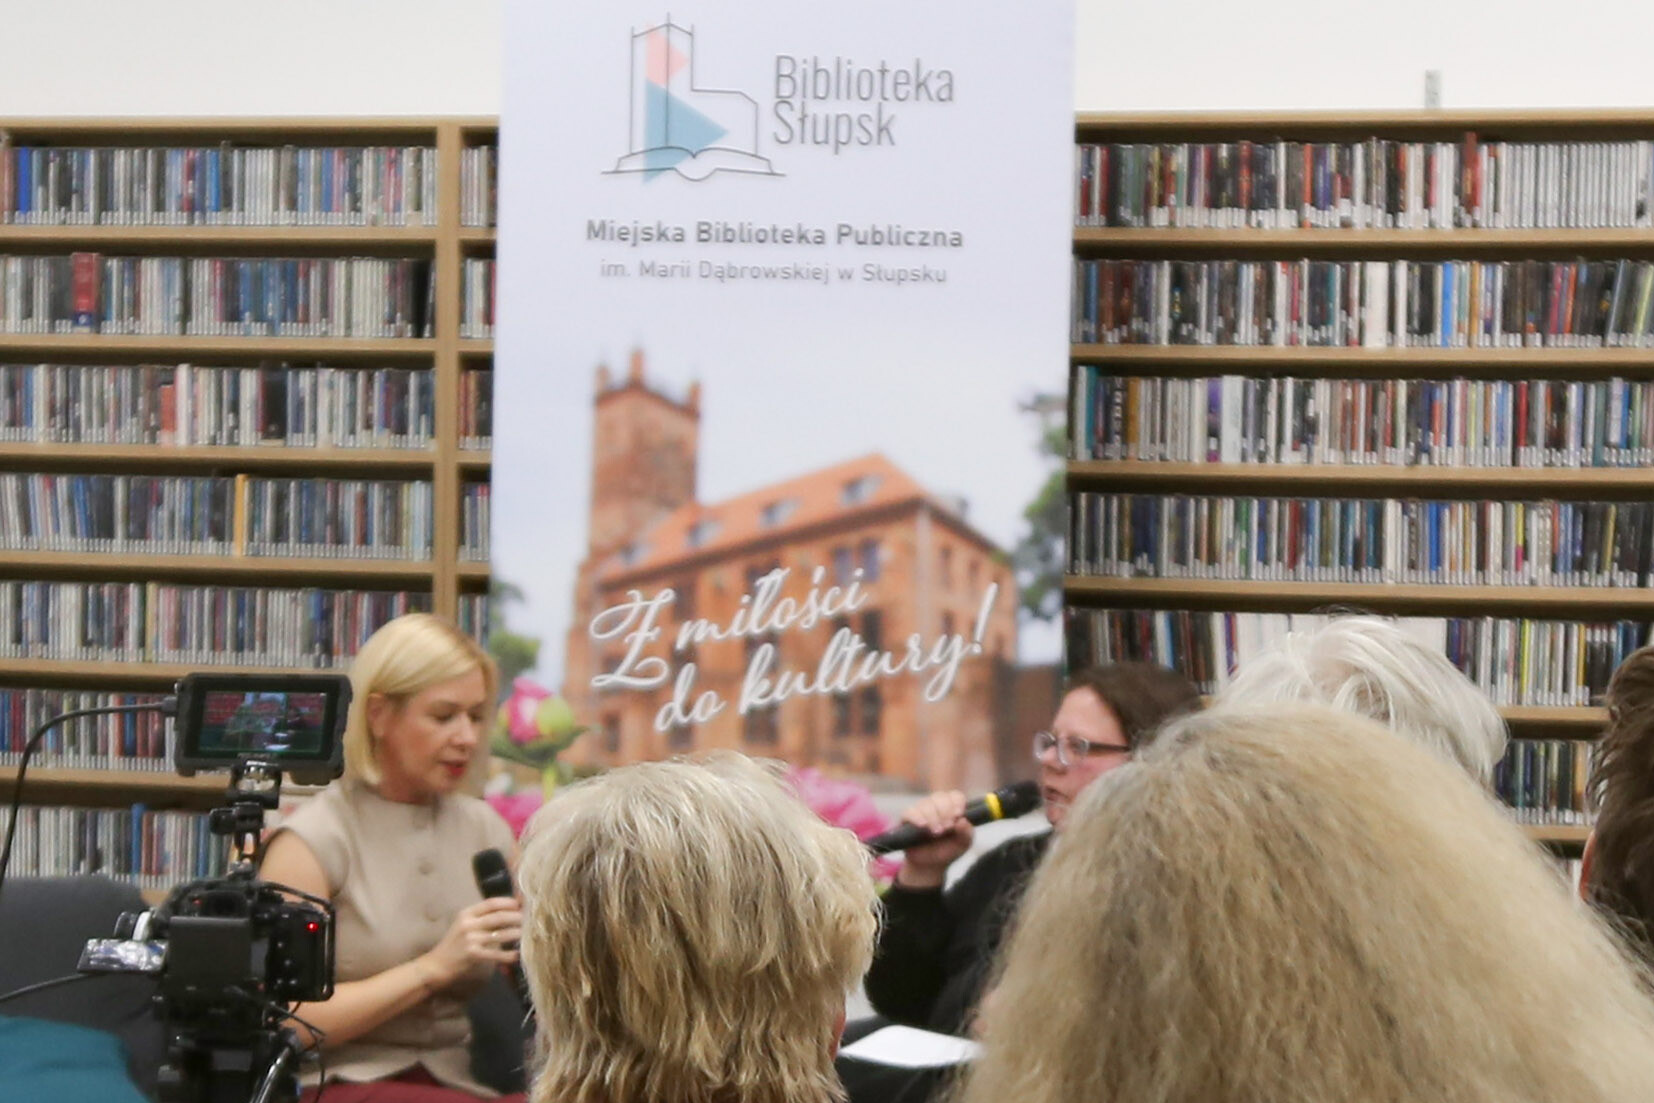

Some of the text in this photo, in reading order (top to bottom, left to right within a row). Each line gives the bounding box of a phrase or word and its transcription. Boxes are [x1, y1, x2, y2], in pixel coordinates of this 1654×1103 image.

[774, 54, 955, 102] Biblioteka
[772, 99, 897, 156] Słupsk
[586, 219, 964, 248] Miejska Biblioteka Publiczna
[600, 259, 949, 285] im. Marii Dąbrowskiej w Słupsku
[589, 566, 868, 689] Z miłości
[654, 582, 999, 734] do kultury!
